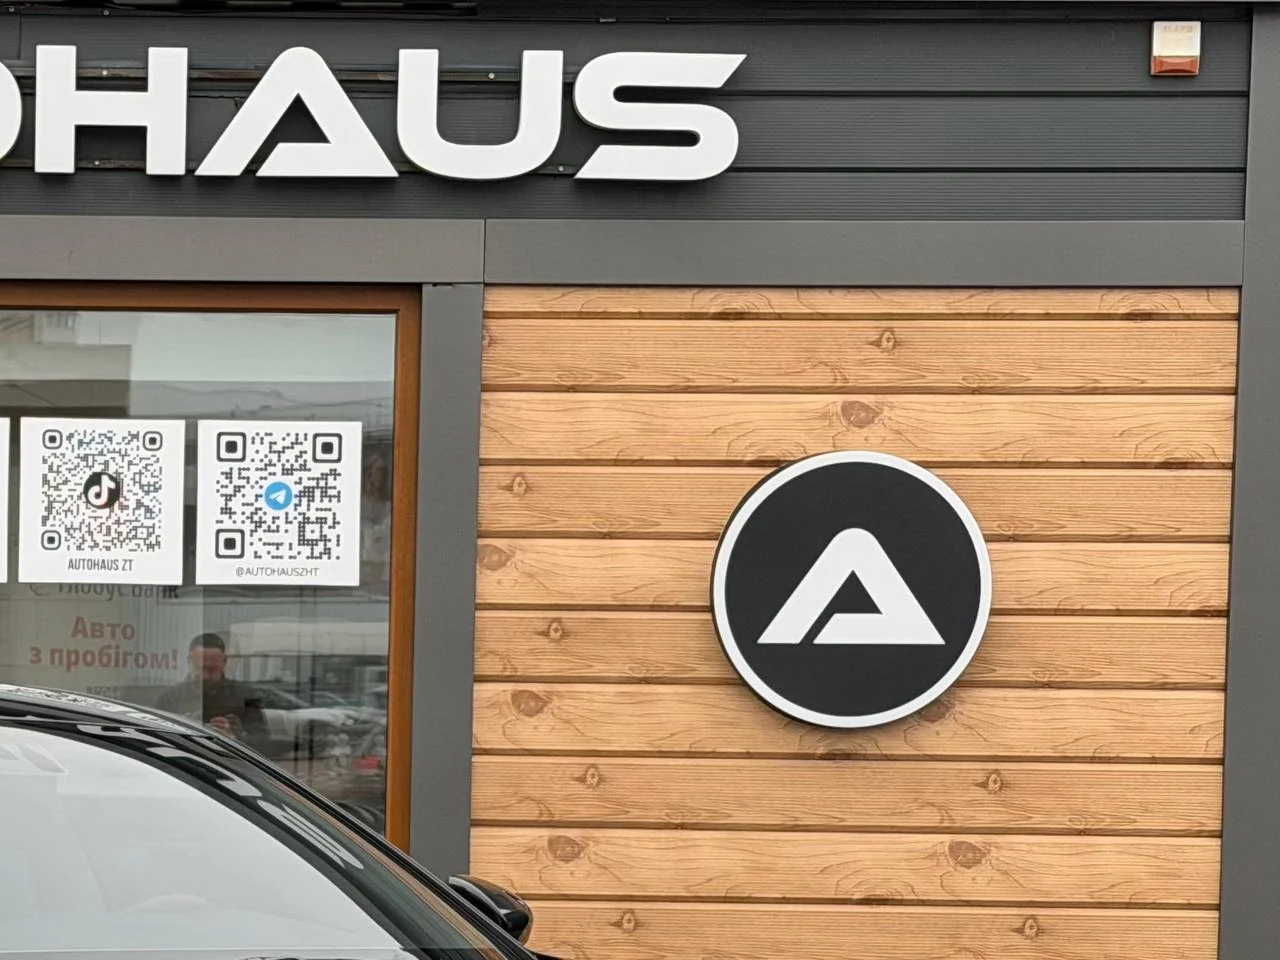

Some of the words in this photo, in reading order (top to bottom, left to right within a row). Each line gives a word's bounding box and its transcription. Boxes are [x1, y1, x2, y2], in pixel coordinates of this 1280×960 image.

[67, 558, 119, 571] AUTOHAUS
[235, 567, 320, 577] @AUTOHAUSZHT
[71, 616, 135, 640] Авто
[49, 645, 178, 672] пробігом!
